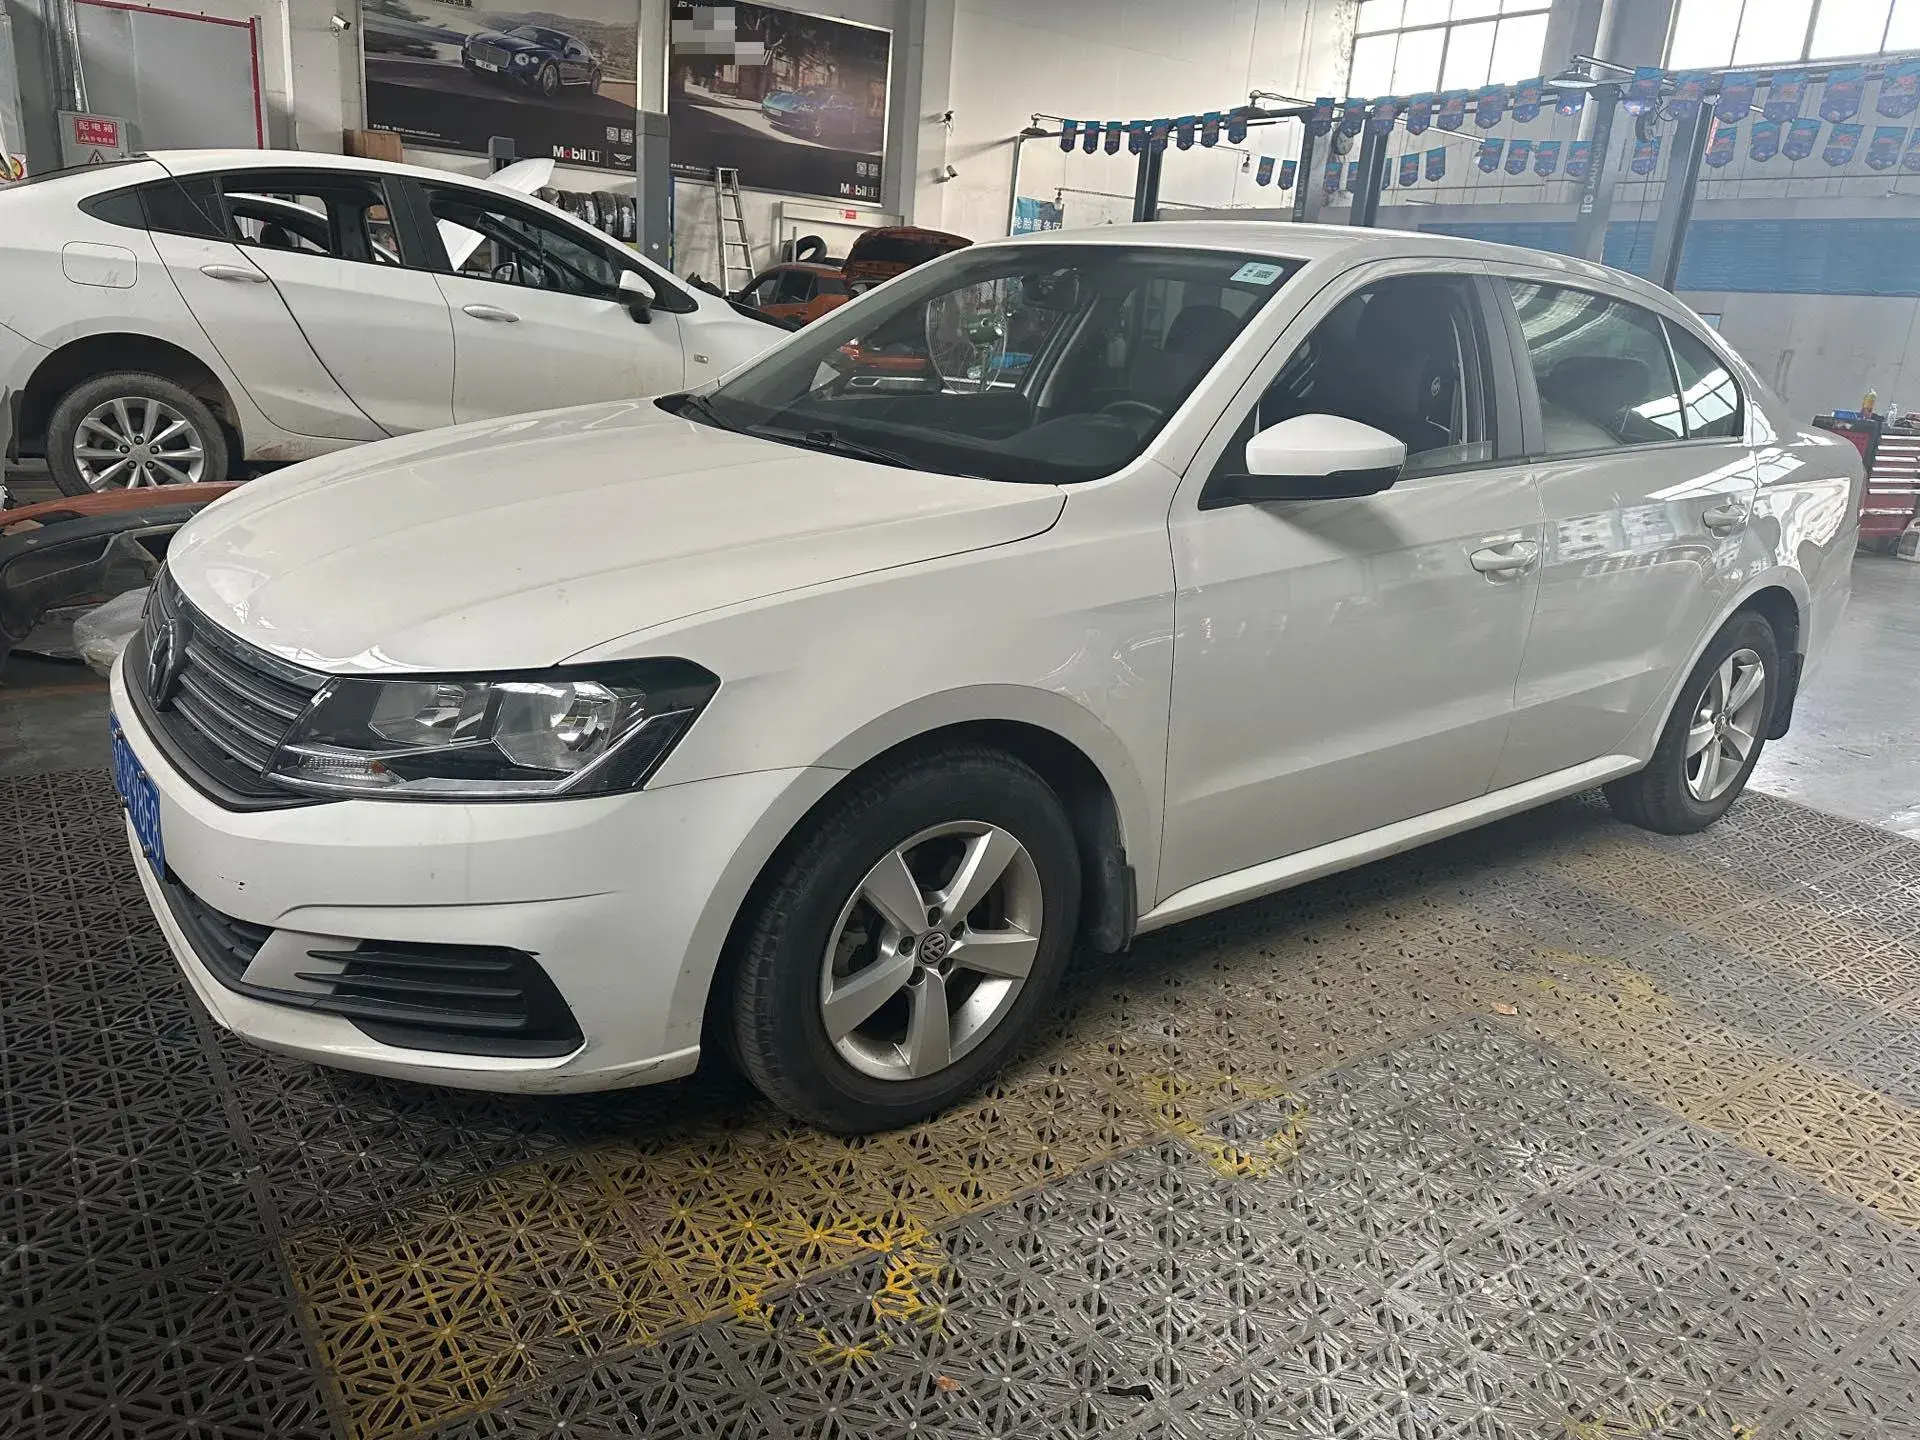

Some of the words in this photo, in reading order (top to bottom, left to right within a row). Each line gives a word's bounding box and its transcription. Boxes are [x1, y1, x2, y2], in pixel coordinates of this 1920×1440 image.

[78, 120, 114, 133] 配电箱
[553, 145, 586, 161] Mobil
[840, 182, 867, 198] Mobil
